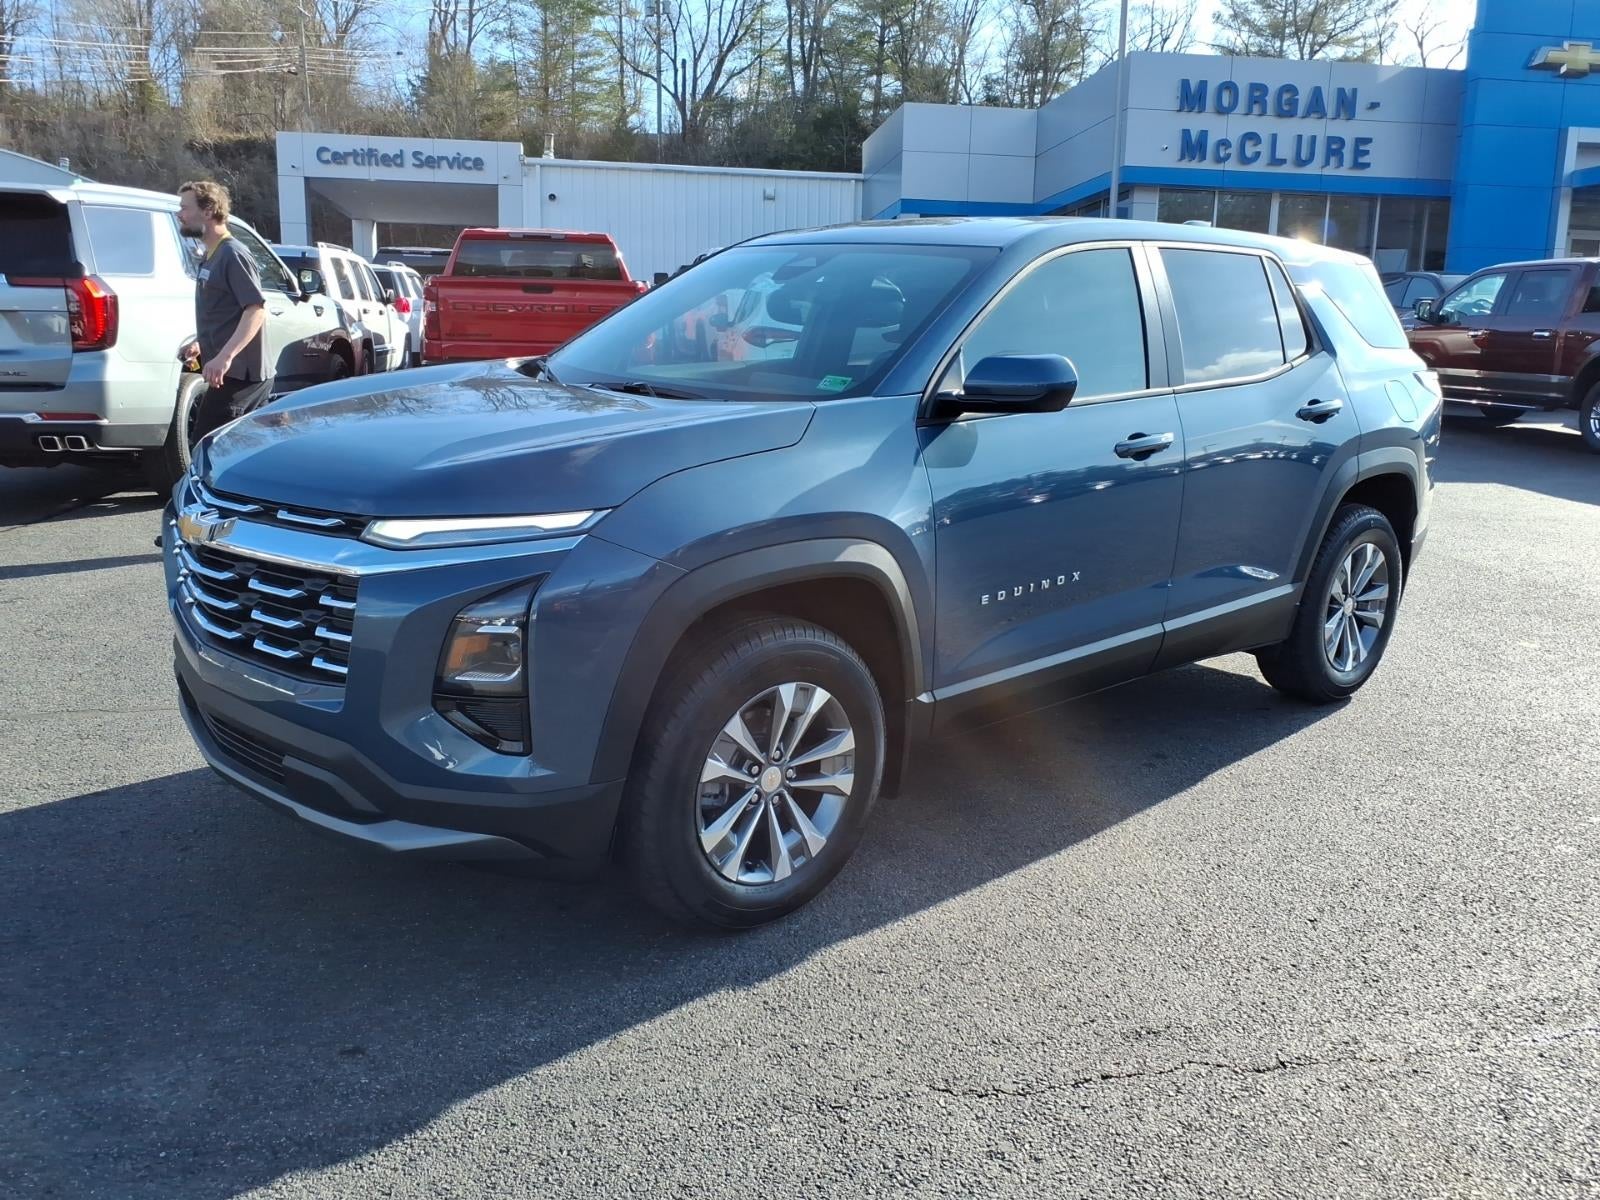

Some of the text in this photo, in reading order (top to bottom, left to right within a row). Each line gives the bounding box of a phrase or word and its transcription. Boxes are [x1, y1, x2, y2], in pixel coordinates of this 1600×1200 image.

[316, 146, 485, 171] Certified Service
[1178, 128, 1373, 169] McCLURE
[452, 302, 617, 314] CHEVROLE
[981, 571, 1080, 605] EQUINOX
